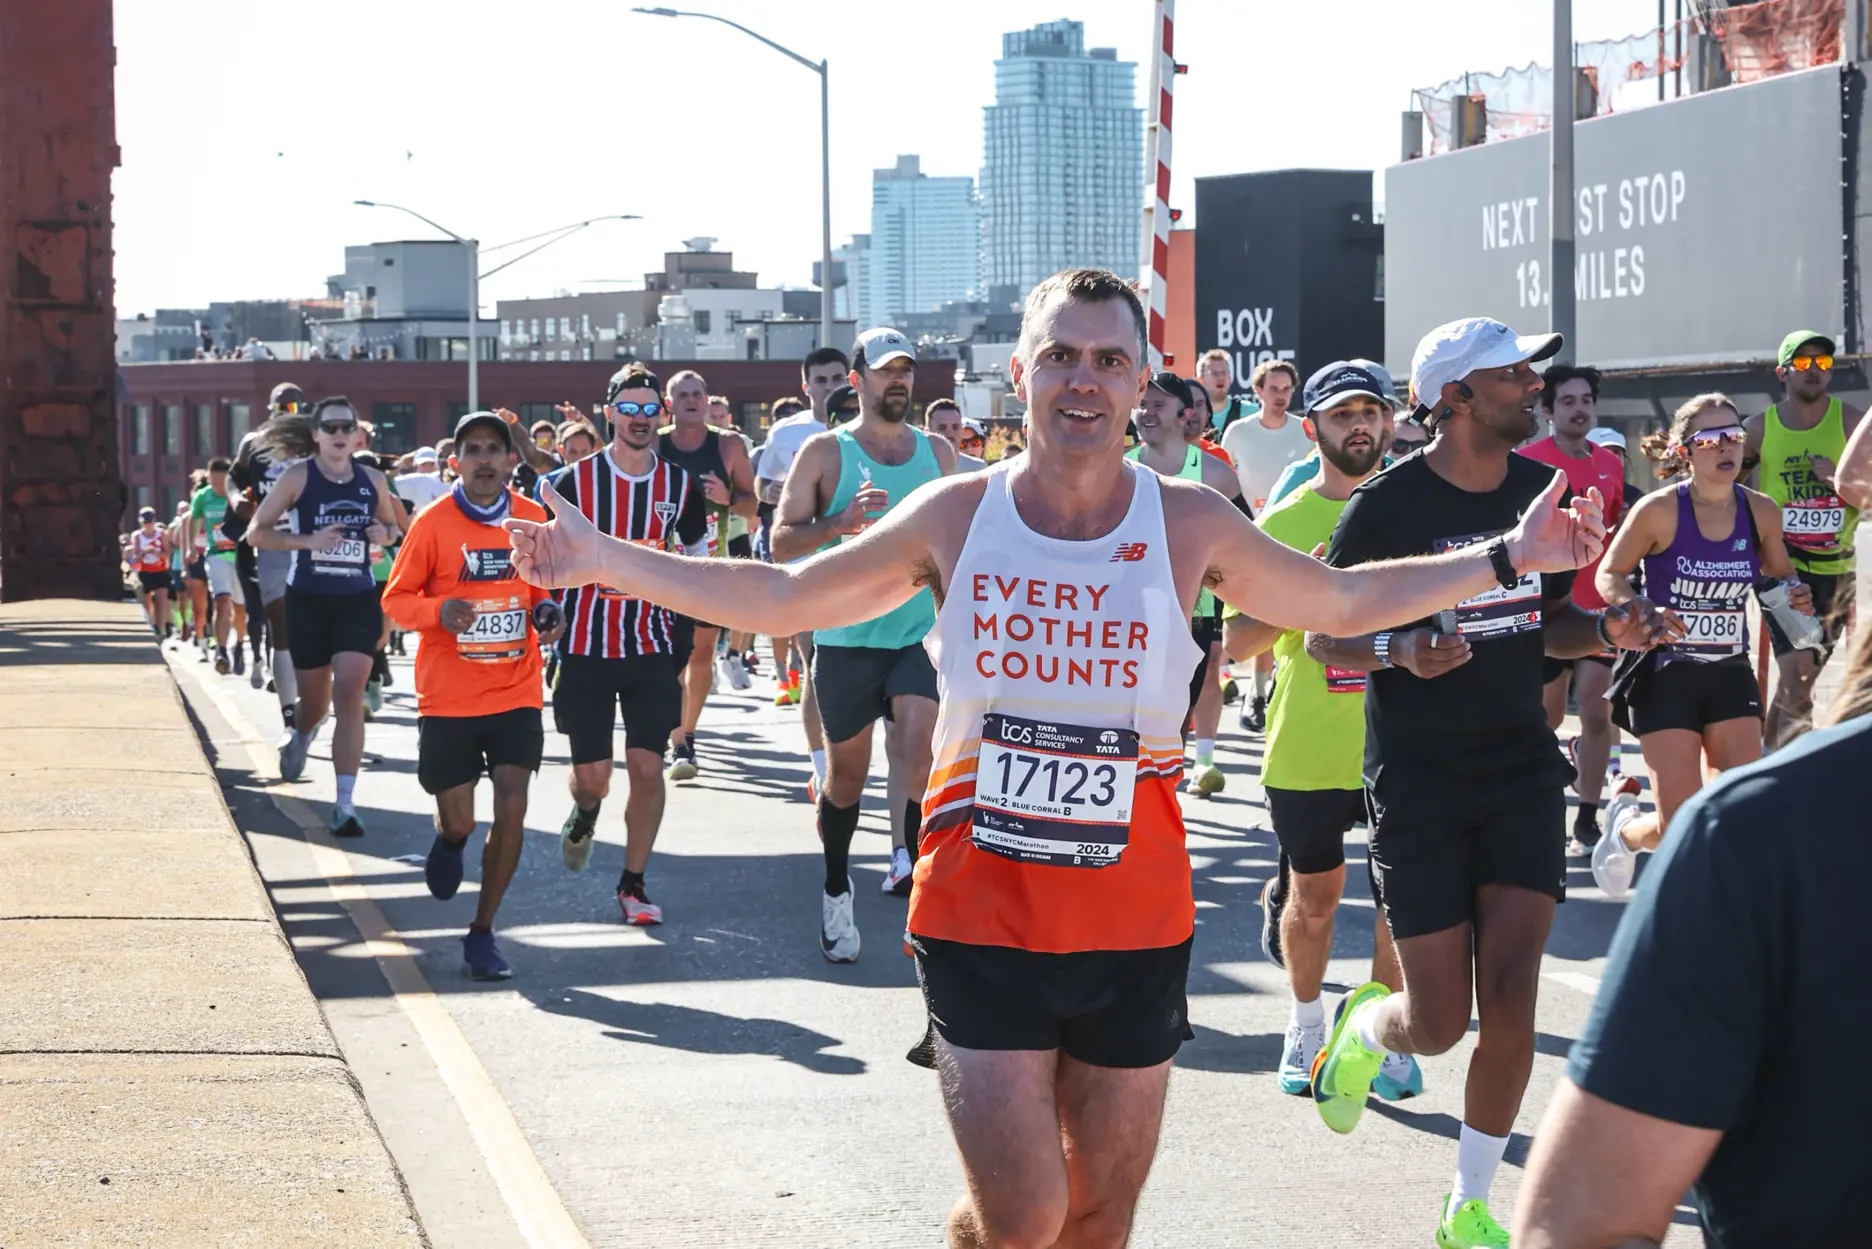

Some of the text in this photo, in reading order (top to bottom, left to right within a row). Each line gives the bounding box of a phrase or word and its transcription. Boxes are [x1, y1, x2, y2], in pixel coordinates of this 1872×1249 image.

[1483, 170, 1685, 250] NEXT ST STOP
[1517, 260, 1549, 308] 13.
[1217, 308, 1273, 347] BOX
[1779, 468, 1819, 486] TEA
[1787, 510, 1842, 528] 24979
[1690, 569, 1753, 578] ASSOCIATION
[1694, 560, 1751, 570] ALZHEIMER'S
[973, 574, 1110, 611] EVERY
[1501, 591, 1507, 599] C
[1680, 598, 1697, 610] tcs
[973, 612, 1149, 651] MOTHER
[976, 650, 1139, 688] COUNTS
[1001, 718, 1058, 744] tcs TATA
[1035, 731, 1084, 745] CONSULTANCY
[1034, 738, 1066, 750] SERVICES
[1095, 745, 1120, 755] TATA
[997, 751, 1117, 807] 17123
[980, 793, 1072, 817] WAVE 2 BLUE CORRAL B
[987, 833, 1050, 850] #TCSNYCMarathon
[1075, 843, 1110, 856] 2024
[1073, 856, 1082, 865] B
